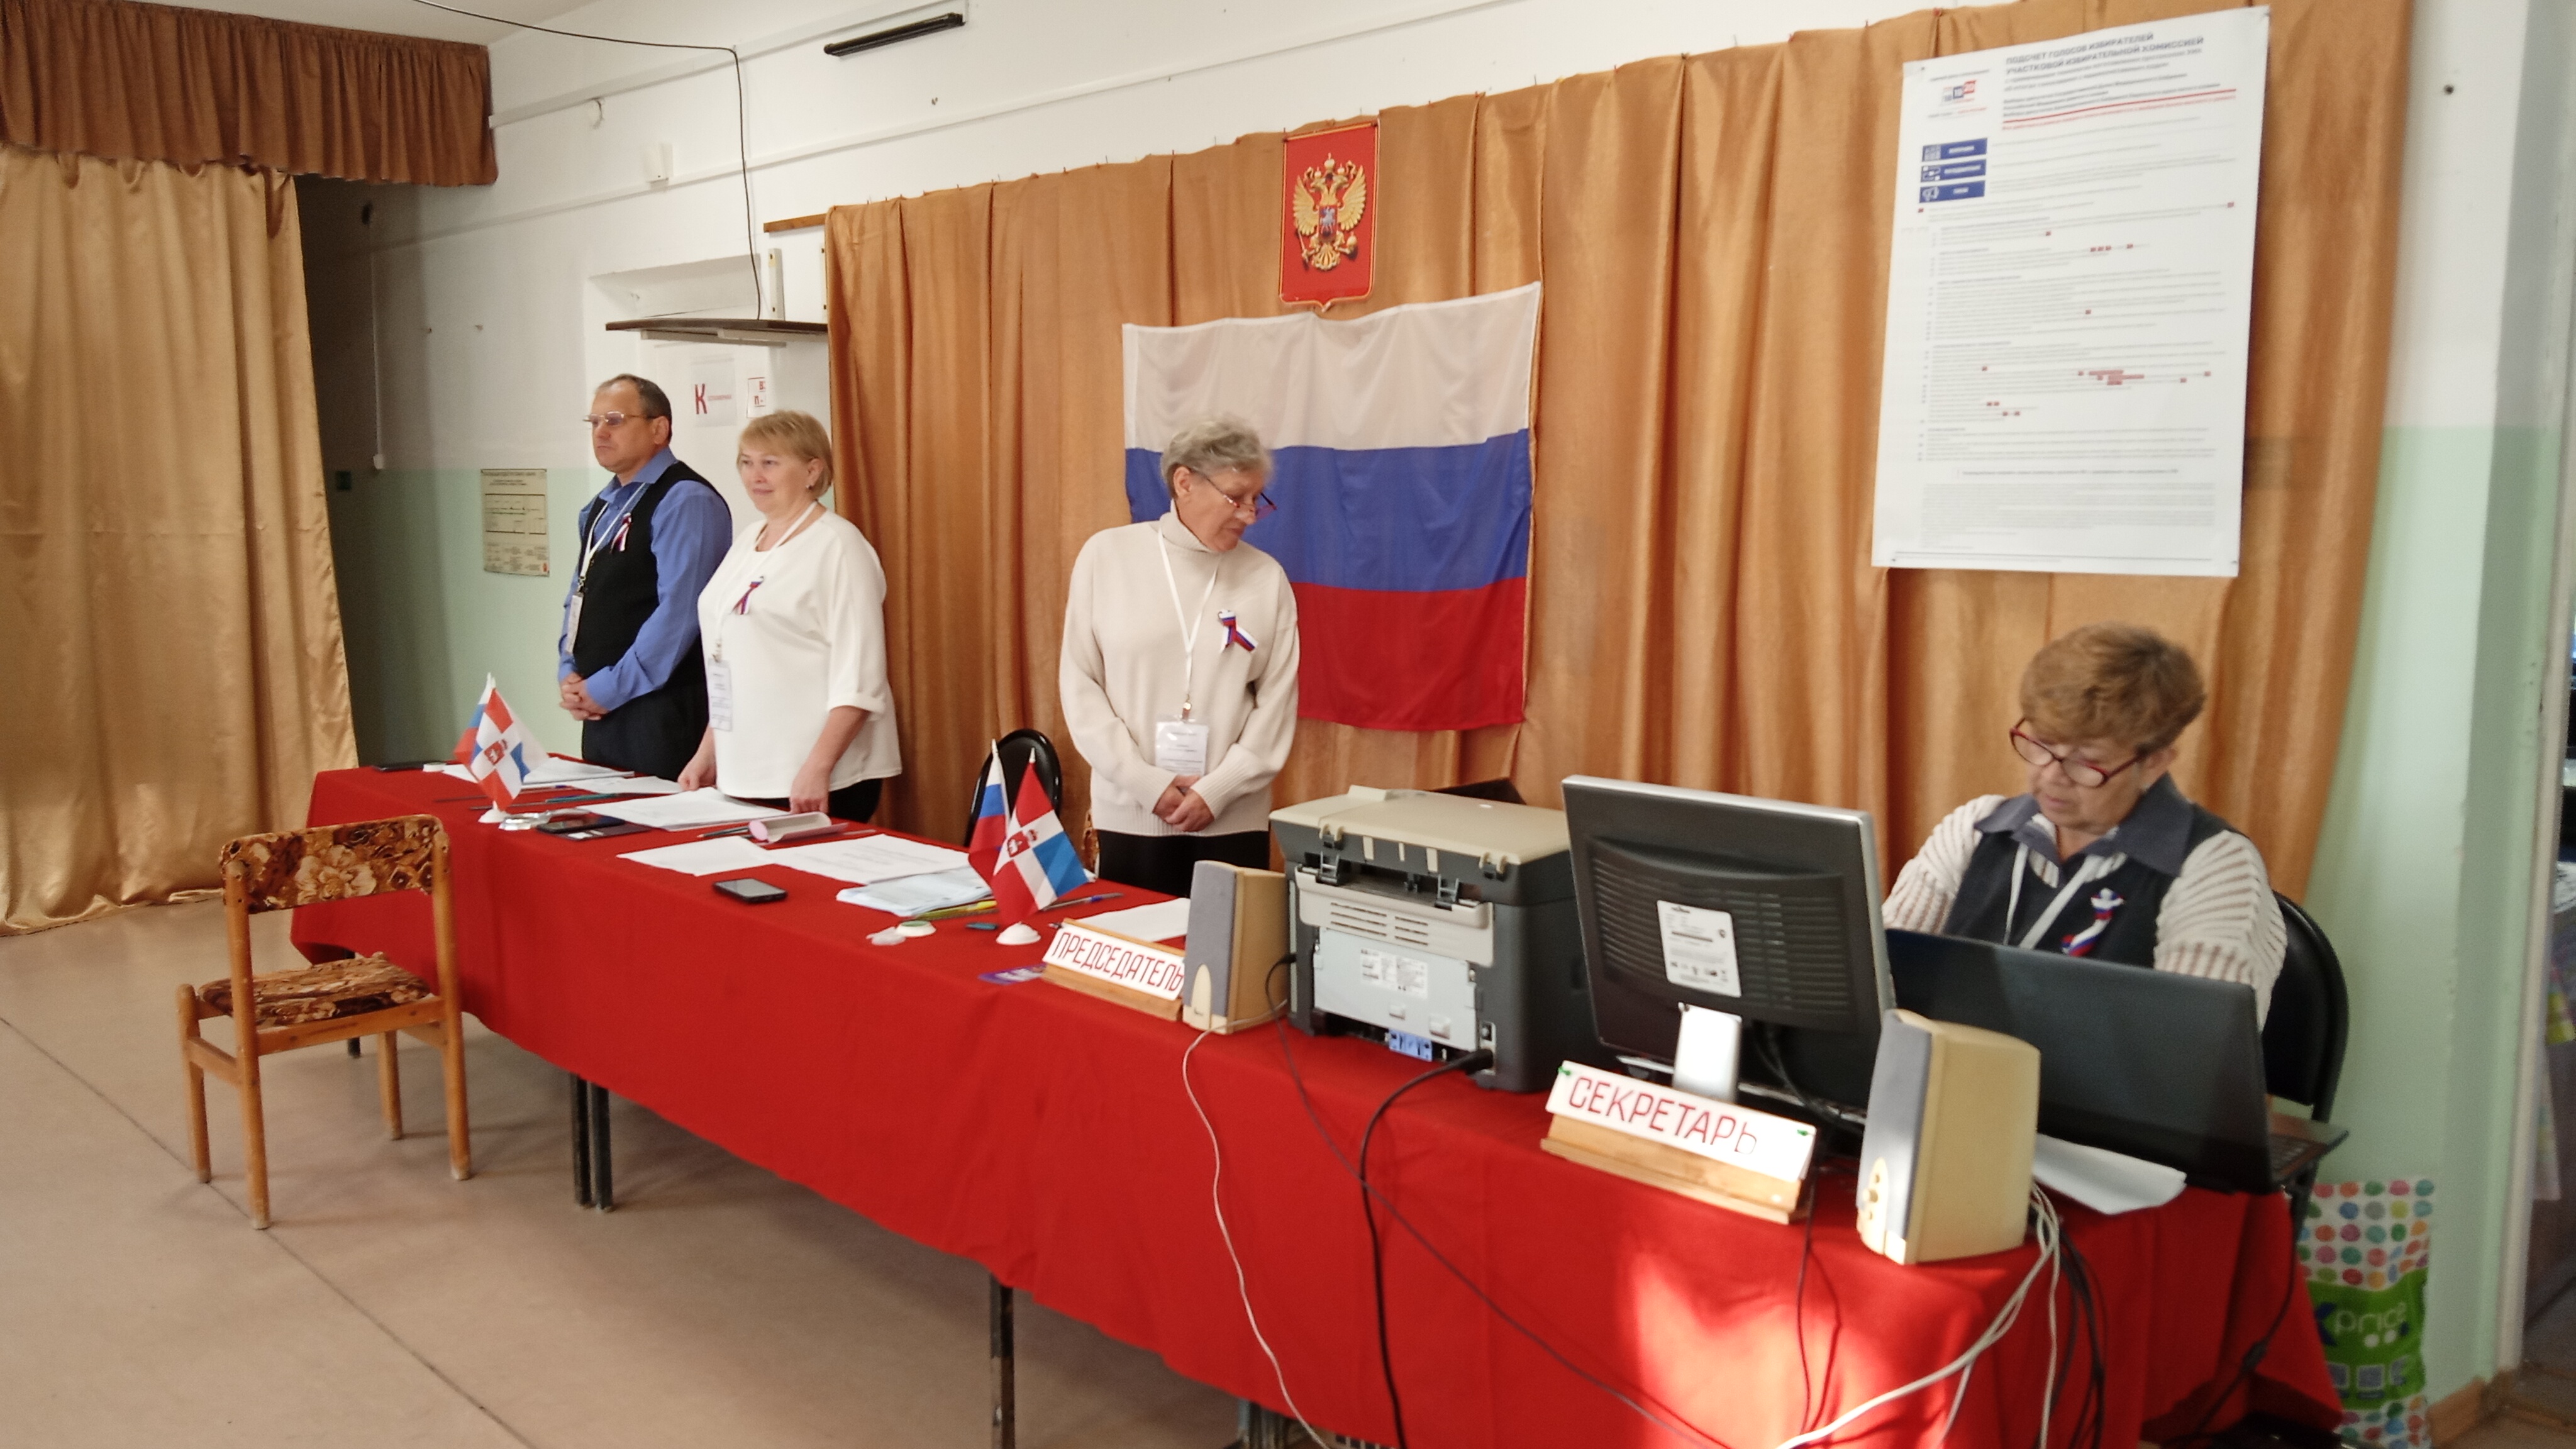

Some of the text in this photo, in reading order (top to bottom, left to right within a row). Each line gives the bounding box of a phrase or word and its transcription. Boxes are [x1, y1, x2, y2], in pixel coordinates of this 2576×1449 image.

[2006, 58, 2064, 74] УЧАСТКОВОЙ
[2066, 44, 2140, 65] ИЗБИРАТЕЛЬНОЙ
[2142, 36, 2204, 53] КОМИССИЕЙ
[2049, 45, 2087, 58] ГОЛОСОВ
[2089, 32, 2153, 50] ИЗБИРАТЕЛЕЙ
[1052, 932, 1184, 991] ПРЕДСЕДАТЕЛЬ
[1568, 1076, 1757, 1155] СЕКРЕТАРЬ
